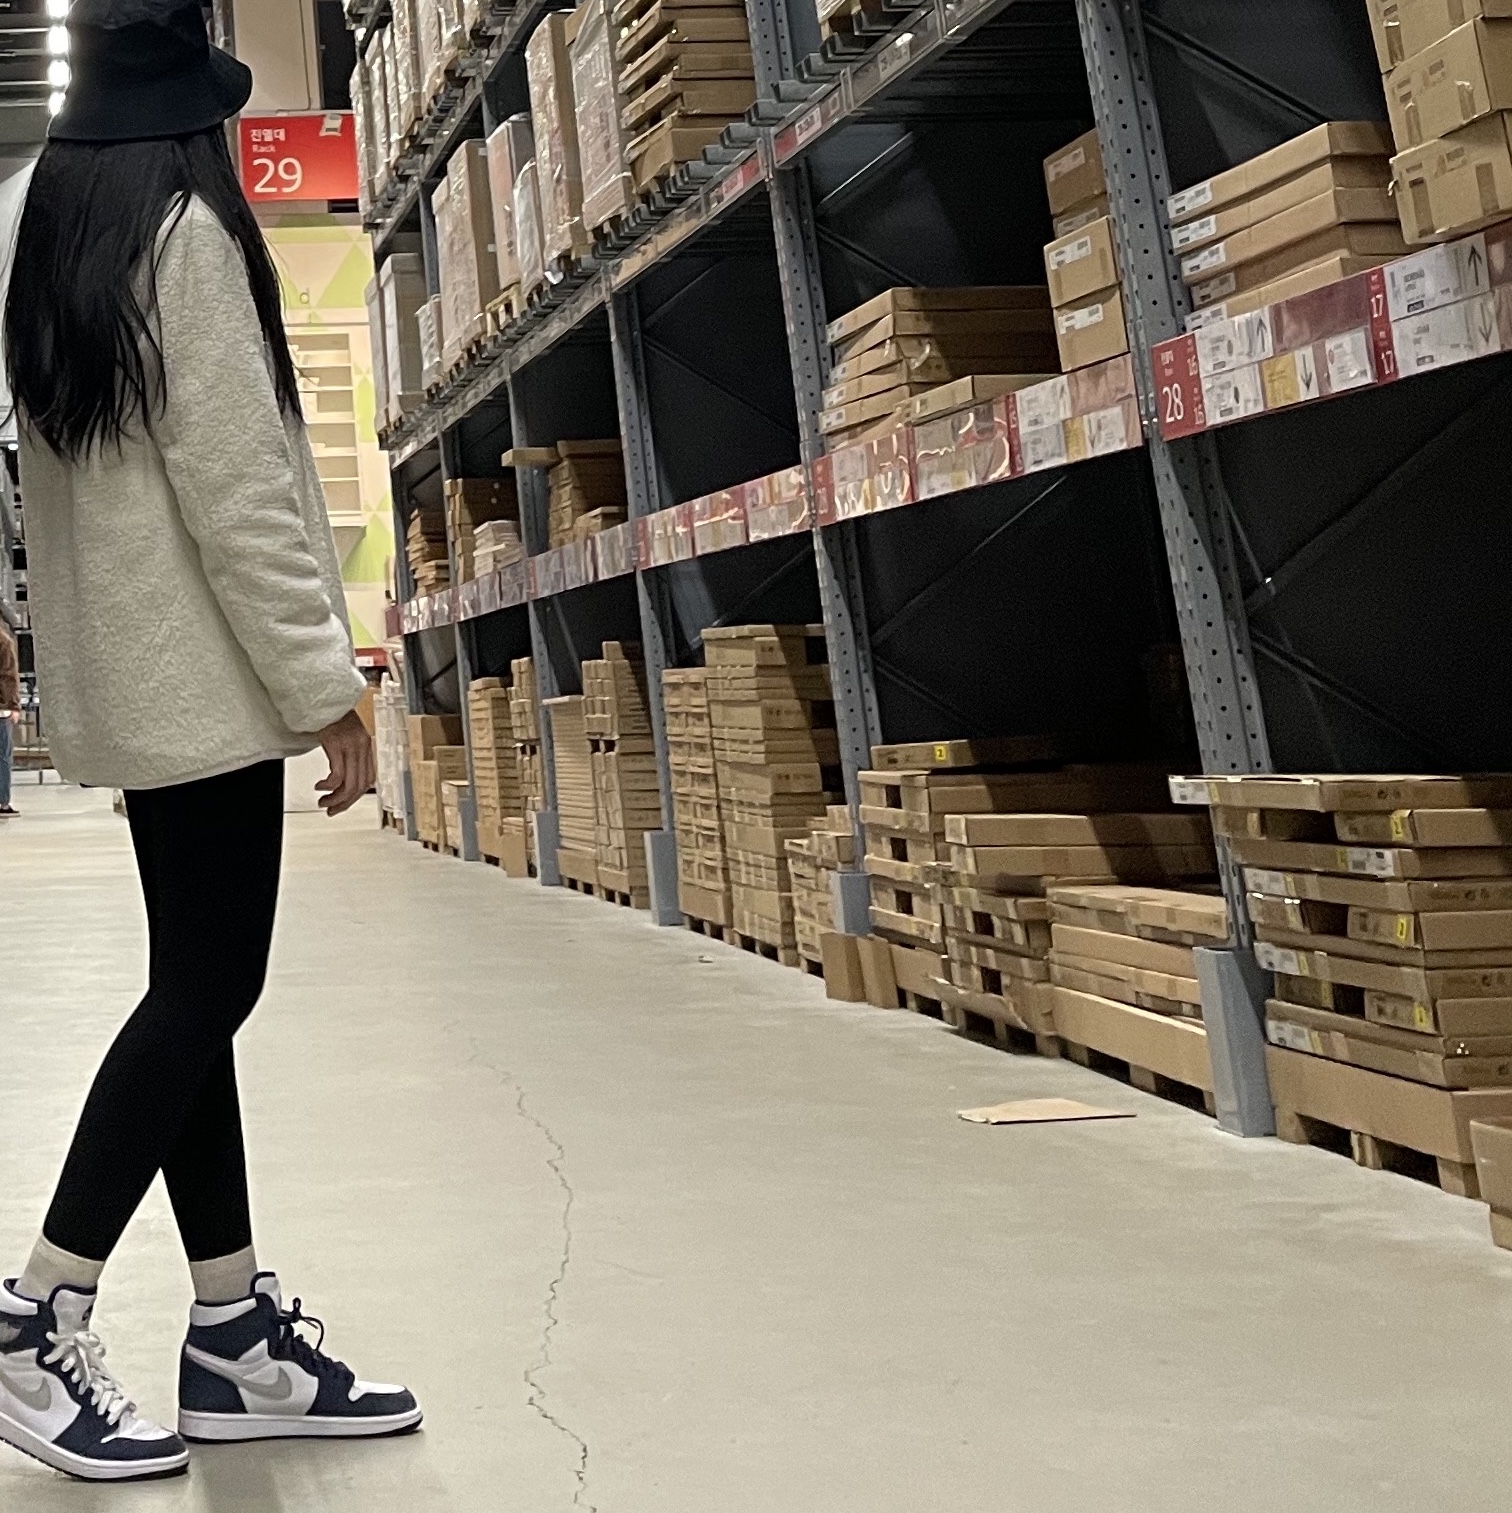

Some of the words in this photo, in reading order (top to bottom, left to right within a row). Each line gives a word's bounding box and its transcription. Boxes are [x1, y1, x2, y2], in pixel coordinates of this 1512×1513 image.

[252, 157, 303, 193] 29
[1370, 293, 1384, 318] 17
[1381, 350, 1395, 375] 17
[1162, 383, 1185, 424] 28
